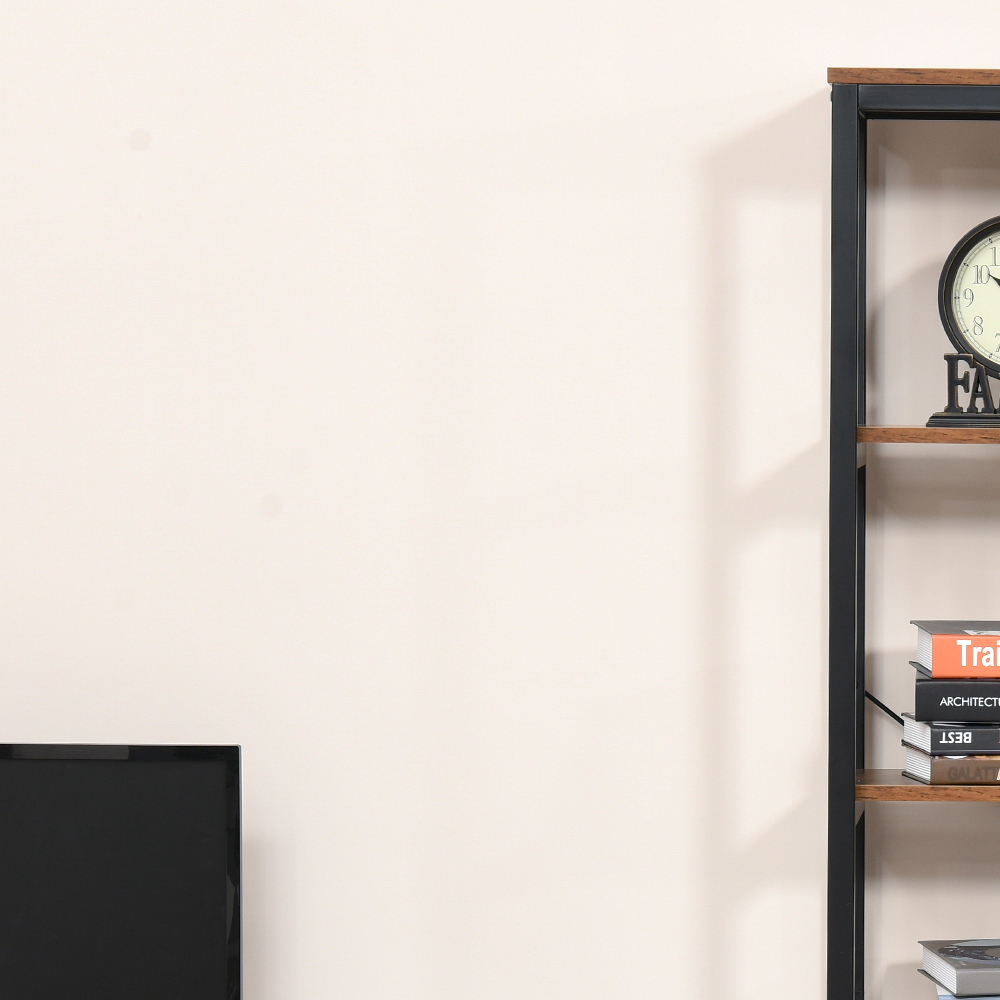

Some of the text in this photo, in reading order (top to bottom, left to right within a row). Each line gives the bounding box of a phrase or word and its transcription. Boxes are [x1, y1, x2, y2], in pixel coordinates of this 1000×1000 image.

[972, 264, 990, 285] 10
[963, 288, 974, 308] 9
[972, 315, 984, 336] 8
[939, 731, 972, 744] BEST
